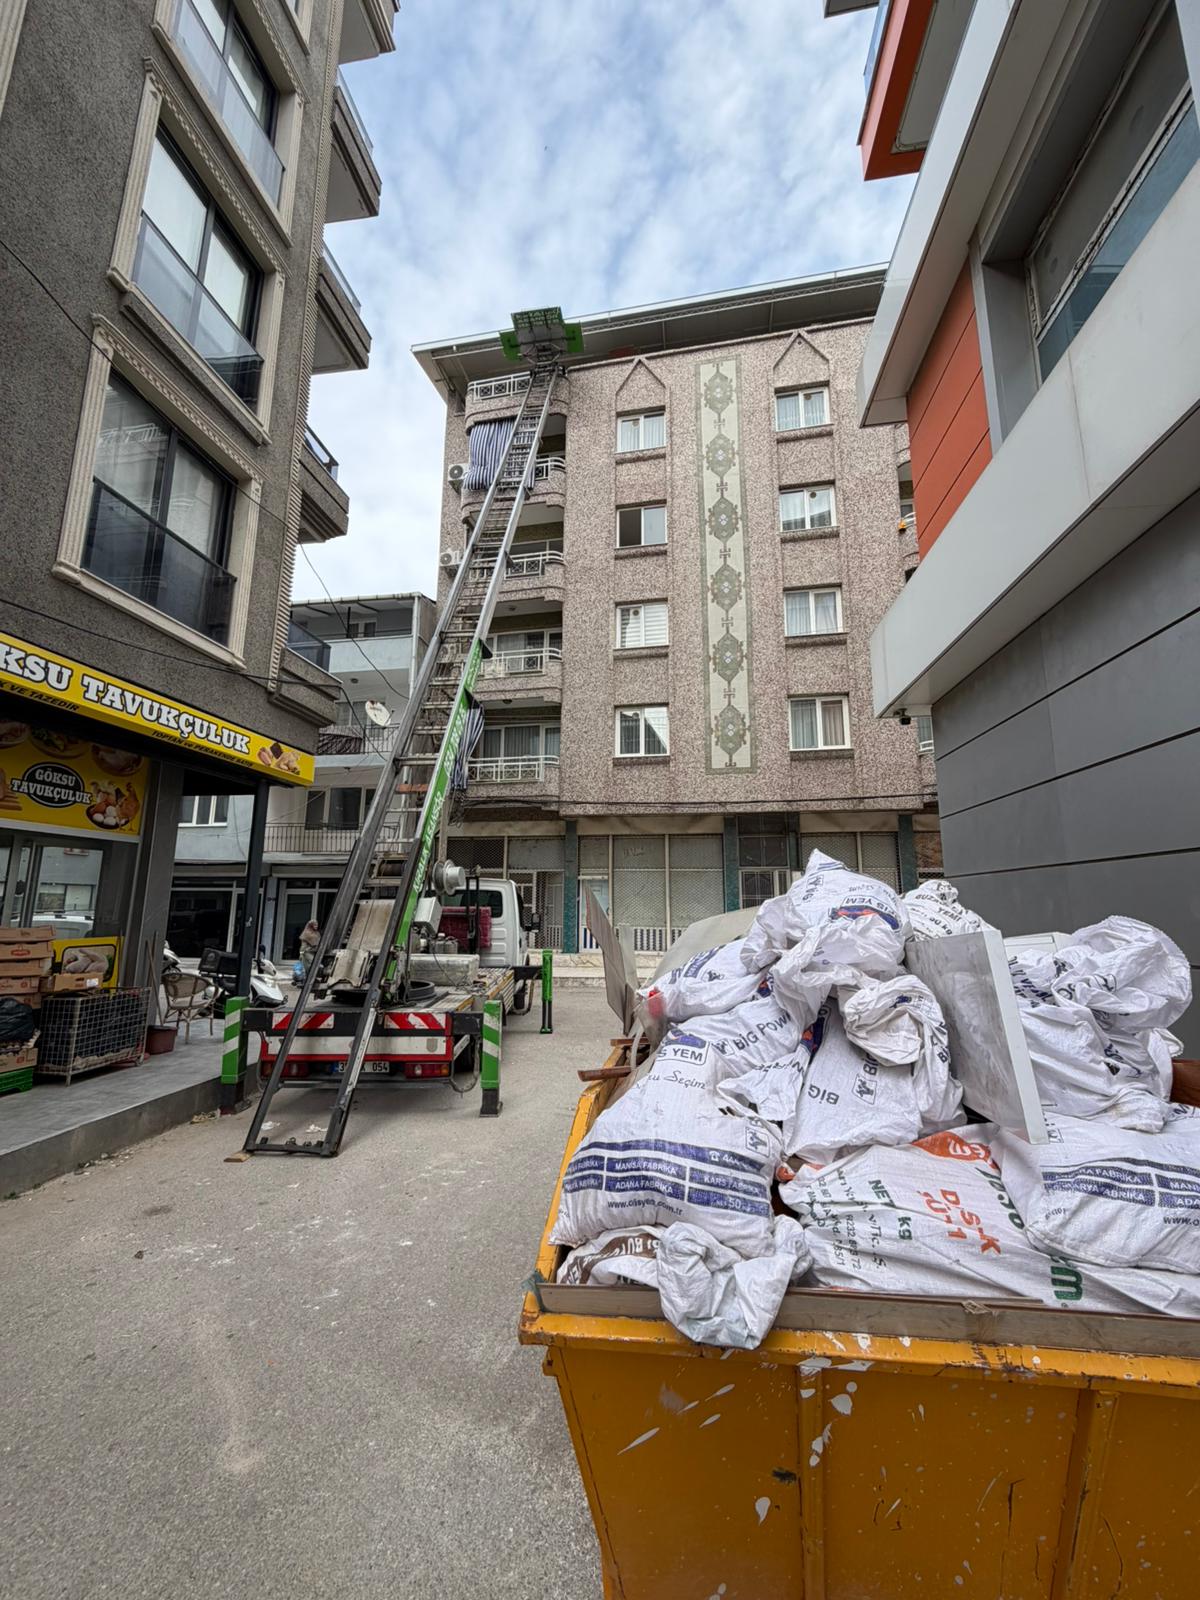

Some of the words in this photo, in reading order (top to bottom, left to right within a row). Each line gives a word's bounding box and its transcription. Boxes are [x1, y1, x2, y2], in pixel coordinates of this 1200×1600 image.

[82, 674, 251, 754] TAVUKÇULUK
[35, 768, 76, 787] GÖKSU
[11, 780, 91, 804] TAVUKÇULUK
[845, 896, 873, 906] YEM
[733, 1030, 760, 1051] BİG
[672, 1048, 704, 1063] YEM
[663, 1070, 706, 1090] Seçim
[808, 1083, 840, 1105] BİG
[615, 1181, 639, 1190] ADANA
[729, 1198, 741, 1209] 50
